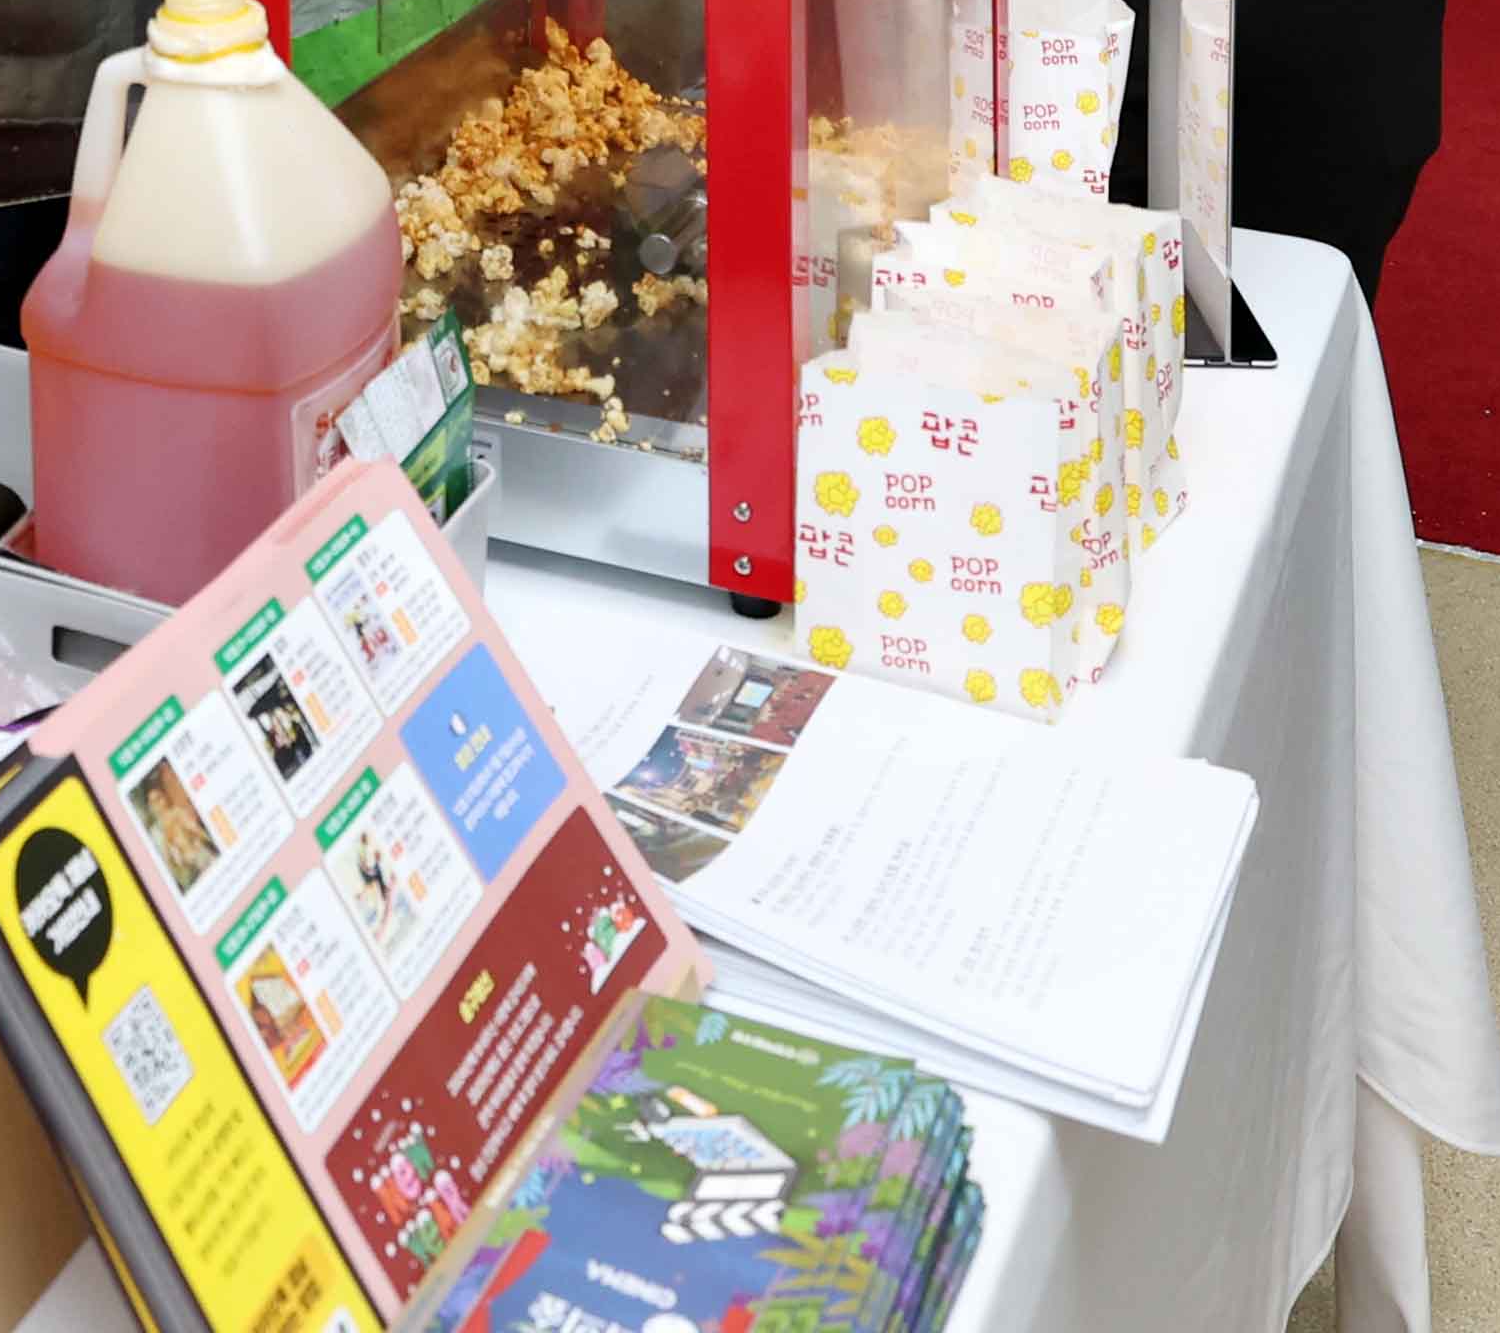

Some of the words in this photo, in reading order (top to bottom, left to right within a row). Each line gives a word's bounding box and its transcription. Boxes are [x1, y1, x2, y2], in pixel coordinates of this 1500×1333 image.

[921, 411, 979, 457] 팝콘
[884, 474, 934, 494] POP
[884, 492, 937, 513] corn
[799, 524, 855, 568] 팝콘
[950, 556, 1000, 577] POP
[949, 575, 1002, 596] corn
[880, 635, 928, 656] POP
[880, 652, 932, 675] corn
